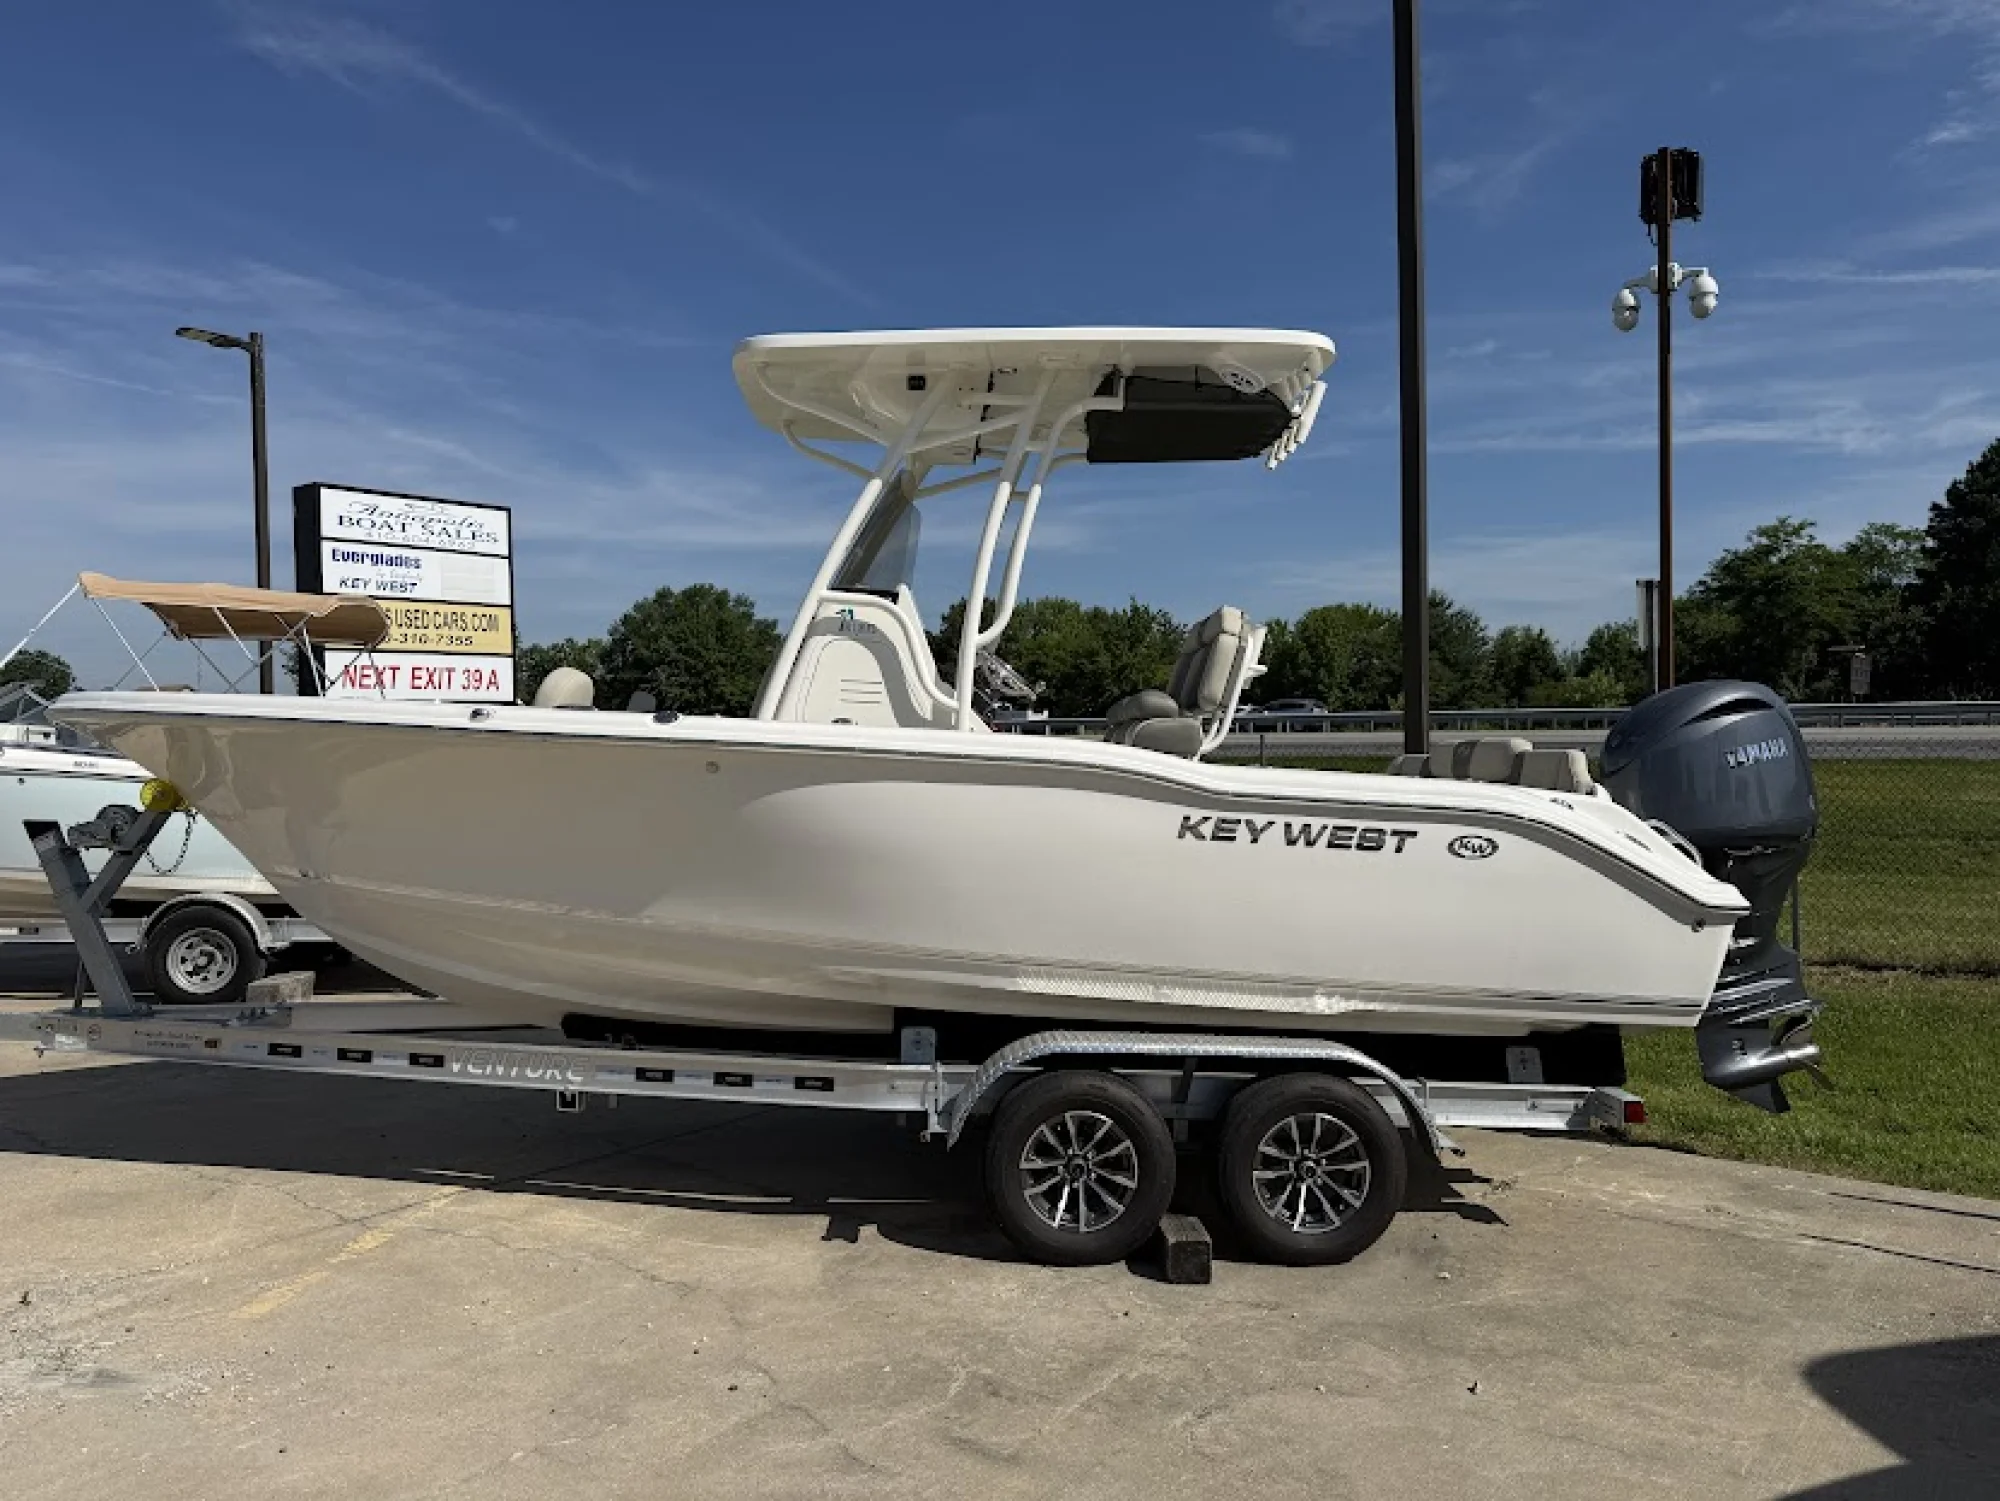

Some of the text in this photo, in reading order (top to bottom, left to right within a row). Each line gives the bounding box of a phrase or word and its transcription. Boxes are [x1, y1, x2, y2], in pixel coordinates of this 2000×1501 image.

[337, 514, 499, 544] BOAT SALES
[332, 548, 422, 569] Everglades
[339, 575, 371, 591] KEY
[375, 579, 418, 594] WEST
[394, 608, 430, 630] USED
[342, 664, 500, 692] NEXT EXIT 39 A
[1725, 736, 1789, 769] YAMAHA
[1177, 815, 1420, 854] KEY WEST
[452, 1049, 588, 1083] VENTURE
